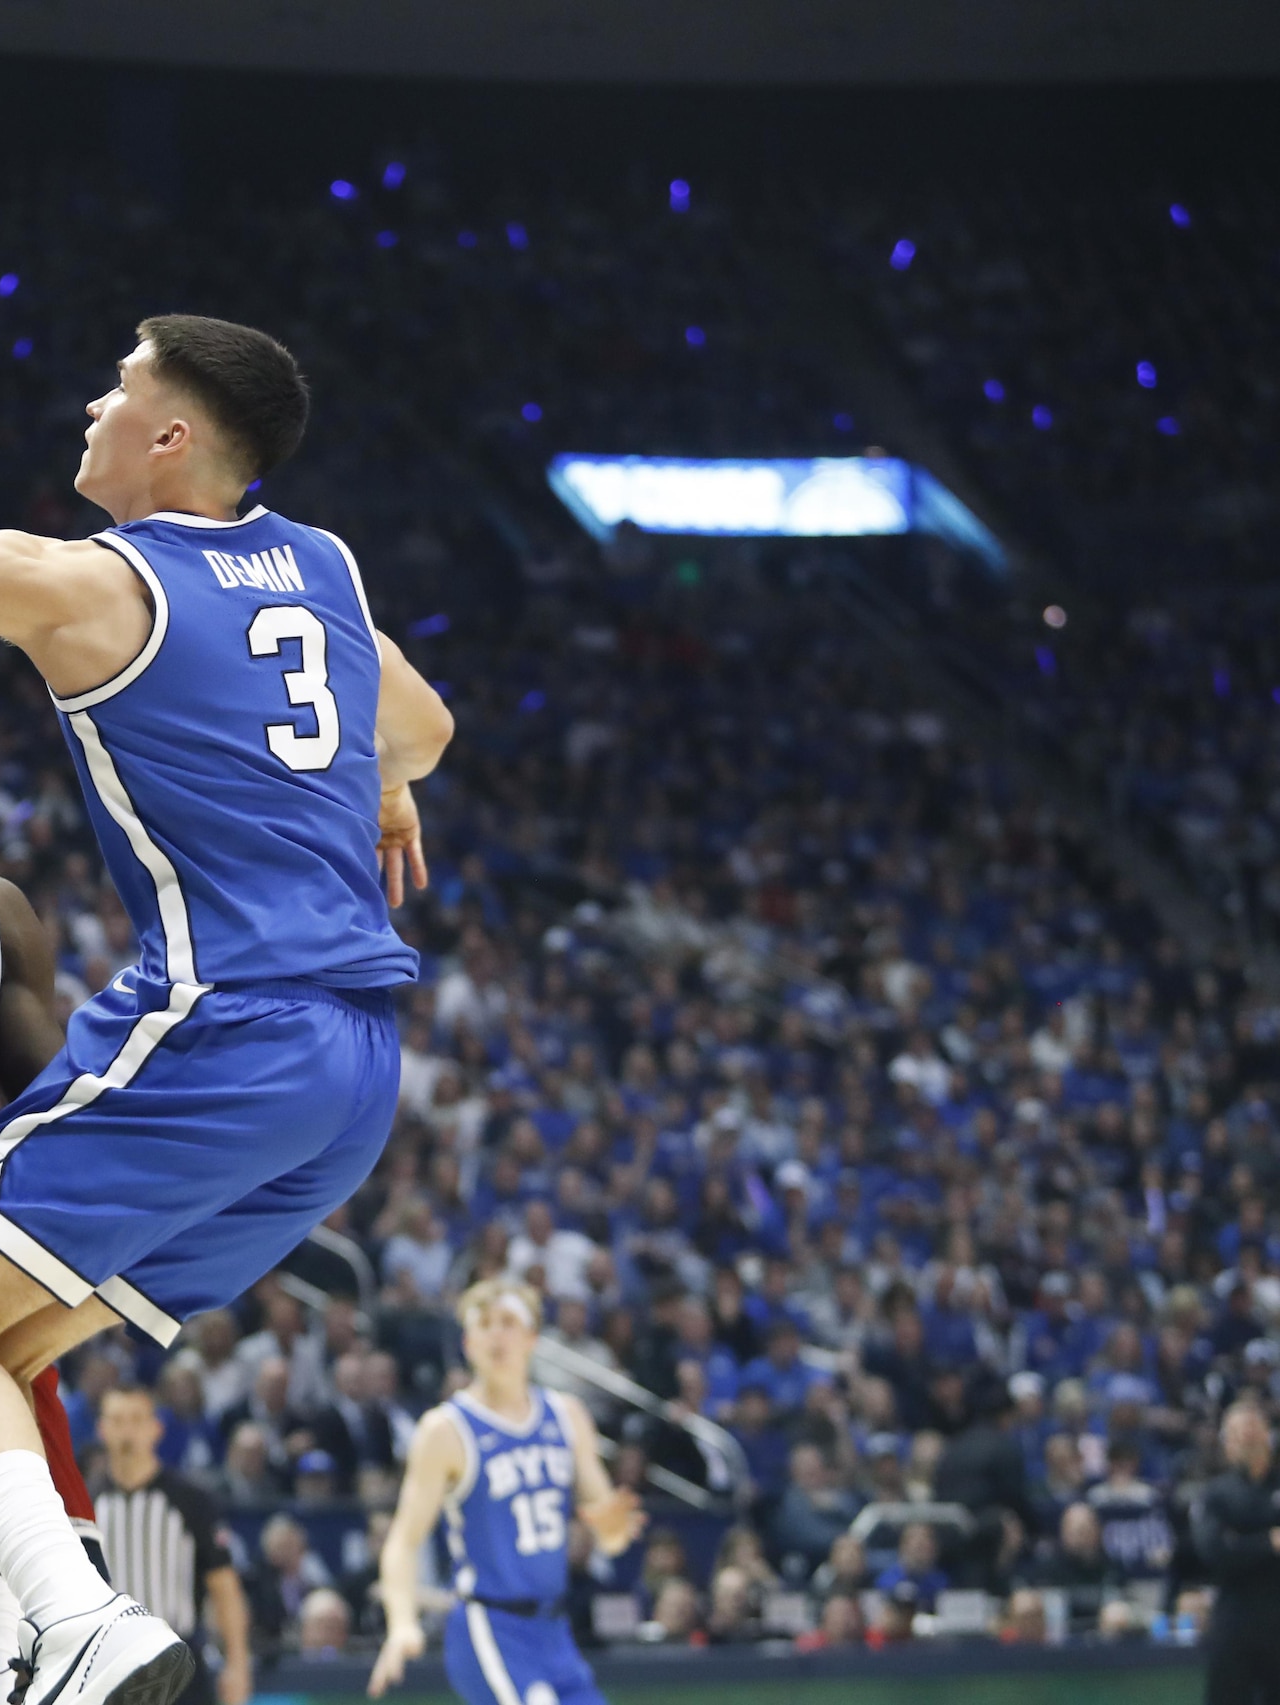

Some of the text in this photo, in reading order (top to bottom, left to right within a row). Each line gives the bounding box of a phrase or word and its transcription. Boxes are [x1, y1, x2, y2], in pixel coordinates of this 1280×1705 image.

[201, 544, 306, 592] DEMIN
[246, 603, 341, 774] 3
[485, 1442, 572, 1500] BYU
[510, 1487, 566, 1556] 15
